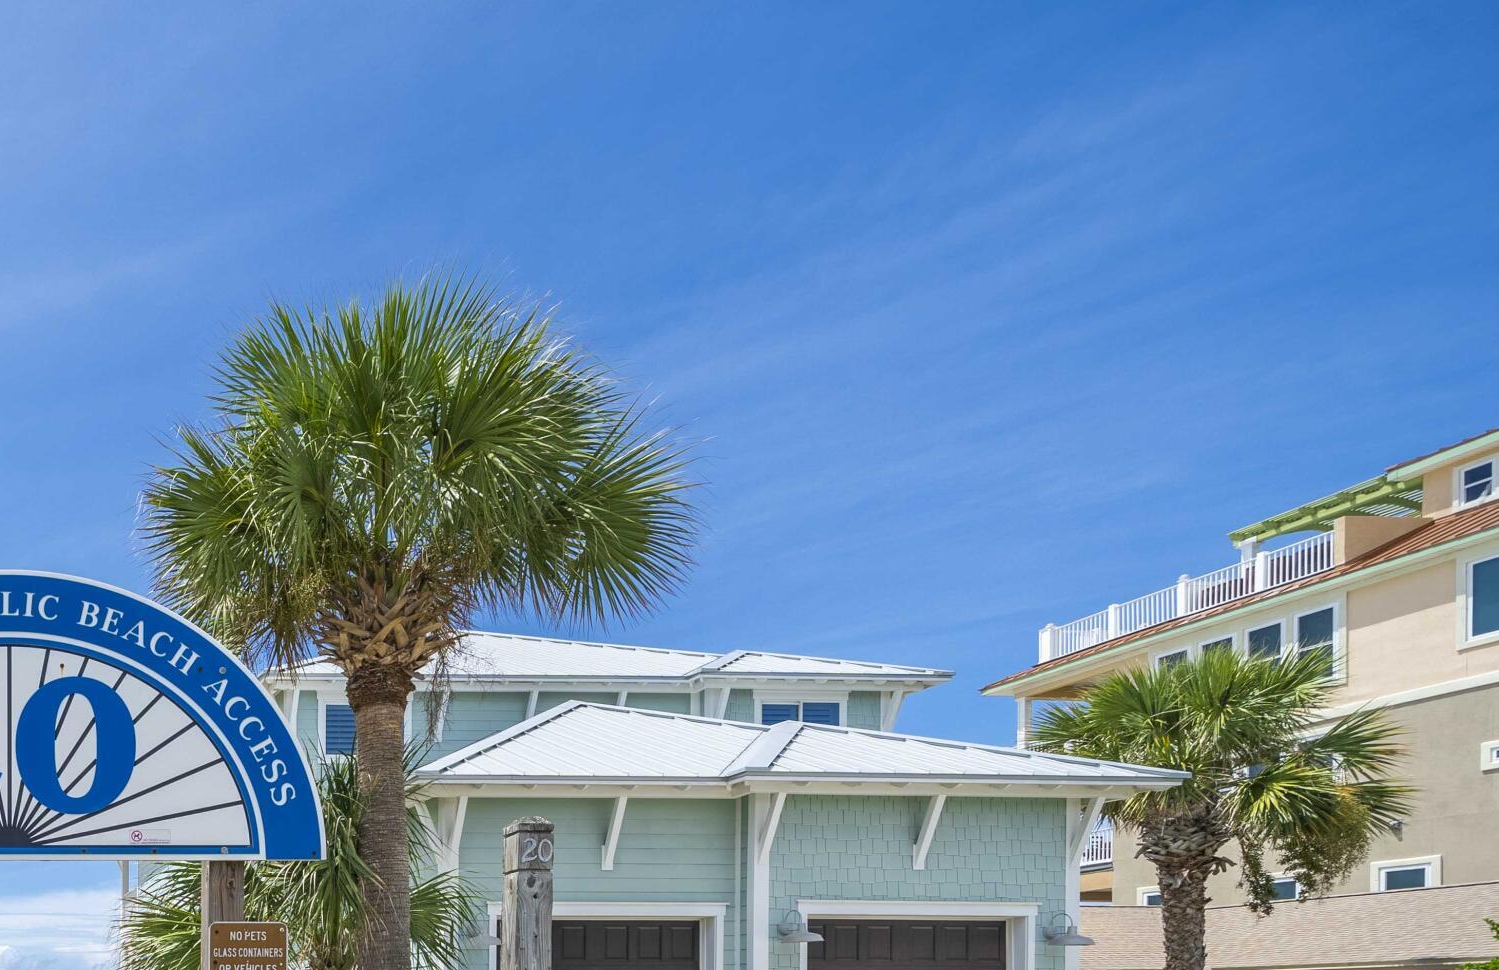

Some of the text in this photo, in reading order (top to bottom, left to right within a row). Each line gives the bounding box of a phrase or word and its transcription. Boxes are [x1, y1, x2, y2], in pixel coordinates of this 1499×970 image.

[76, 600, 201, 676] BEACH
[201, 678, 297, 806] ACCESS
[521, 837, 553, 863] 20
[230, 931, 267, 940] NO PETS
[213, 948, 283, 957] GLASS CONTAINERS
